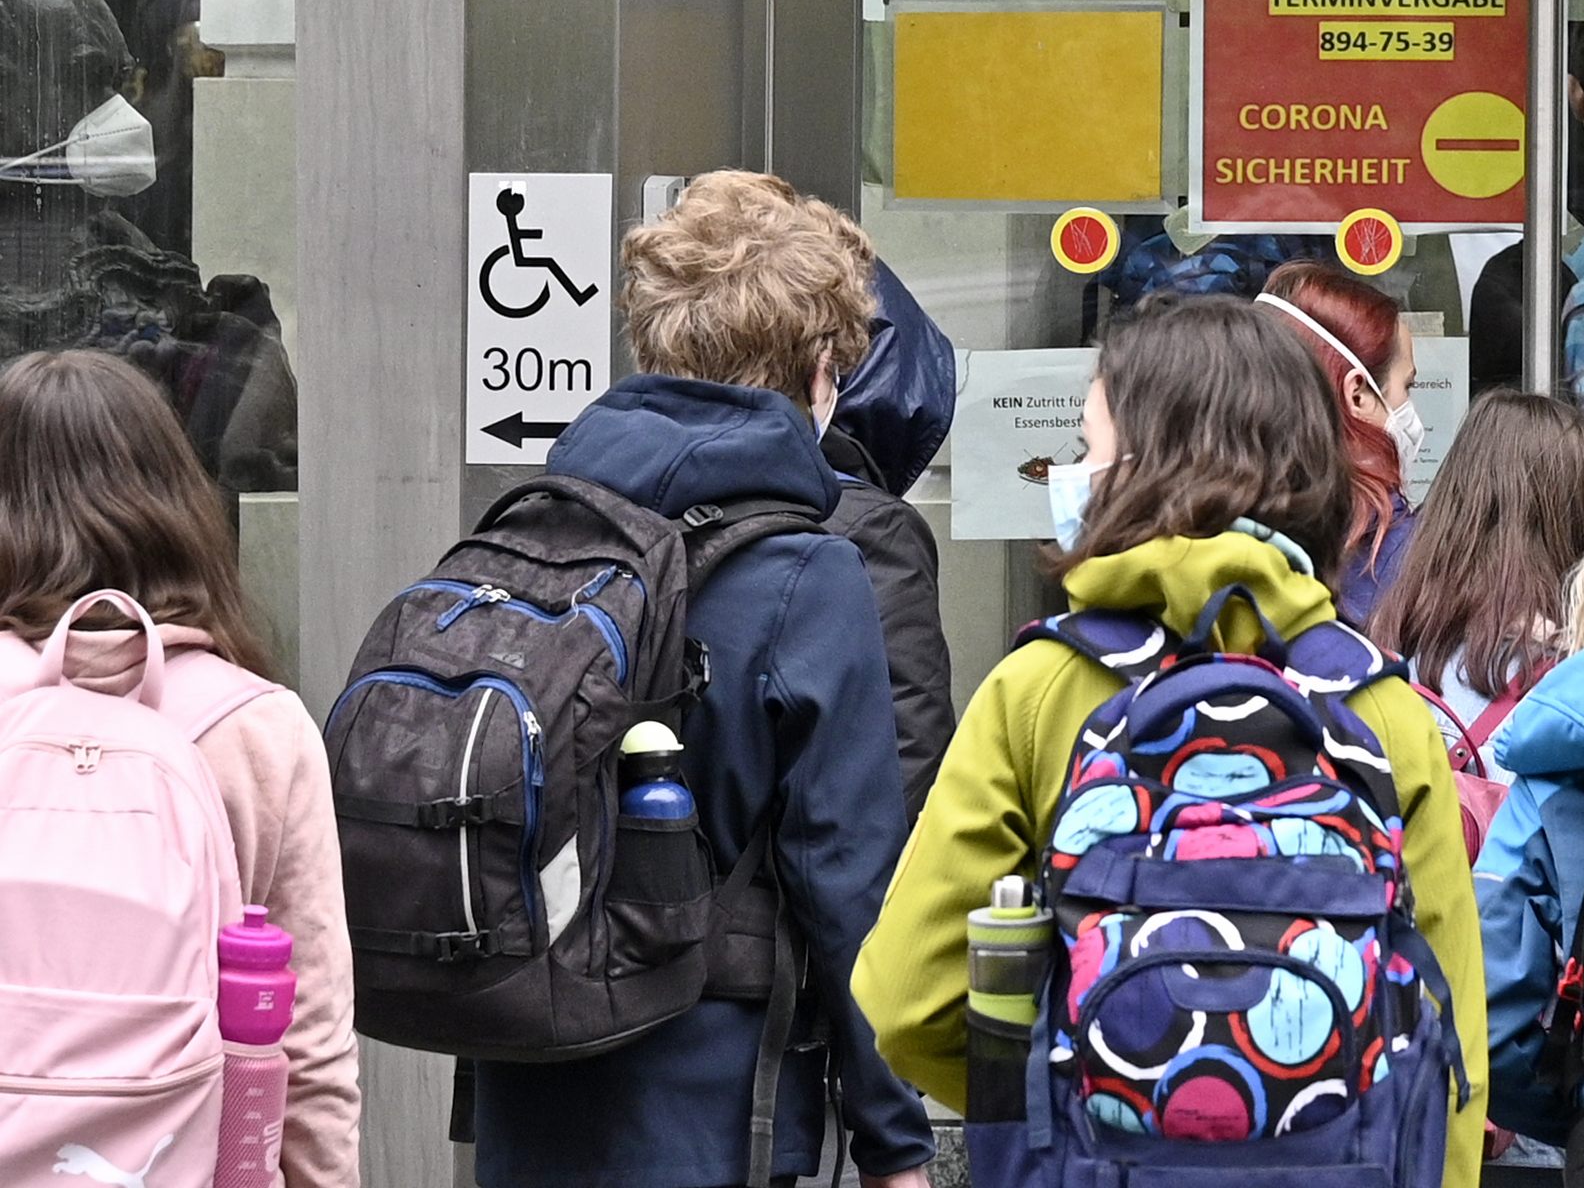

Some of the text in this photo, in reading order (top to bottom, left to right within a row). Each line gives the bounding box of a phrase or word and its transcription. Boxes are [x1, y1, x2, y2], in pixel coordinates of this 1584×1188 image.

[1320, 32, 1454, 53] 894-75-39
[1239, 103, 1388, 131] CORONA
[1215, 157, 1411, 185] SICHERHEIT
[482, 347, 591, 391] 30m
[993, 396, 1085, 408] KEIN Zutritt für
